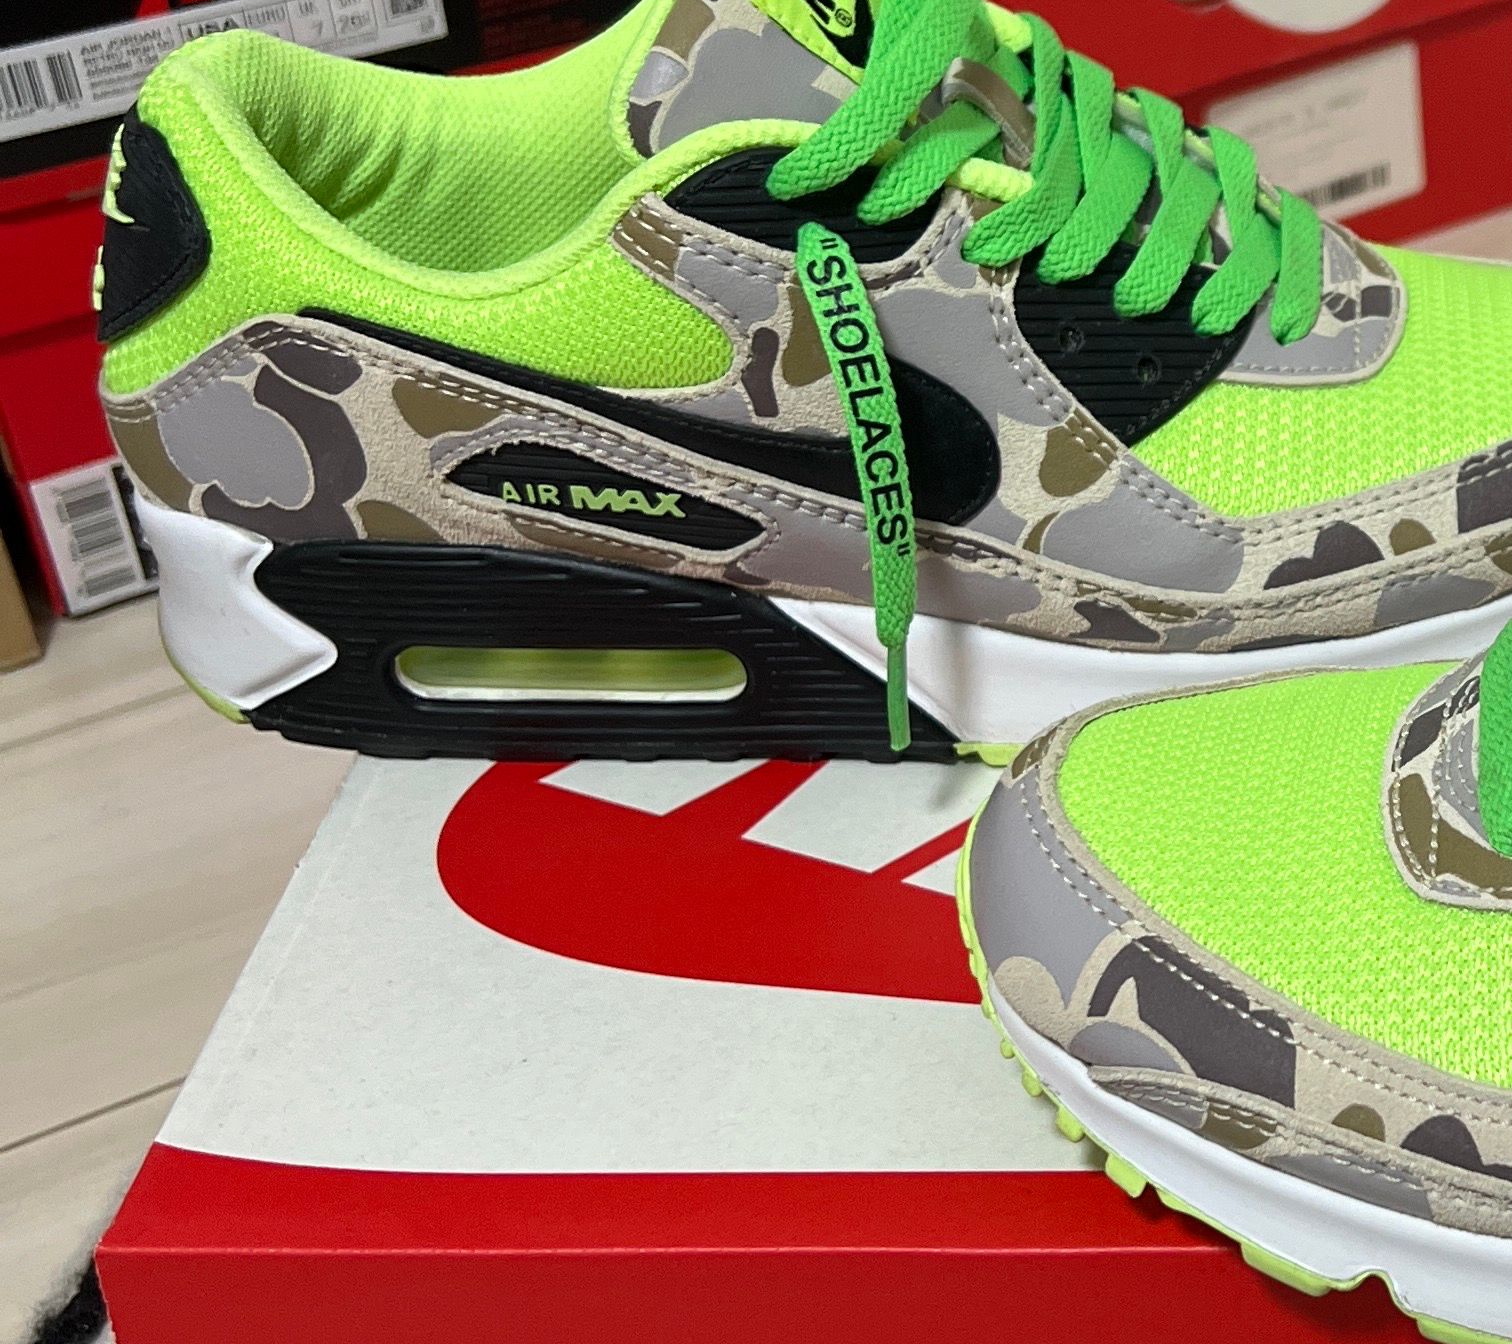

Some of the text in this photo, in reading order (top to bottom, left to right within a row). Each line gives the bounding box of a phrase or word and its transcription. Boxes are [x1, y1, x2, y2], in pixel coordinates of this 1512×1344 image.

[806, 237, 911, 556] "SHOELACES"
[503, 481, 687, 518] AIR MAX
